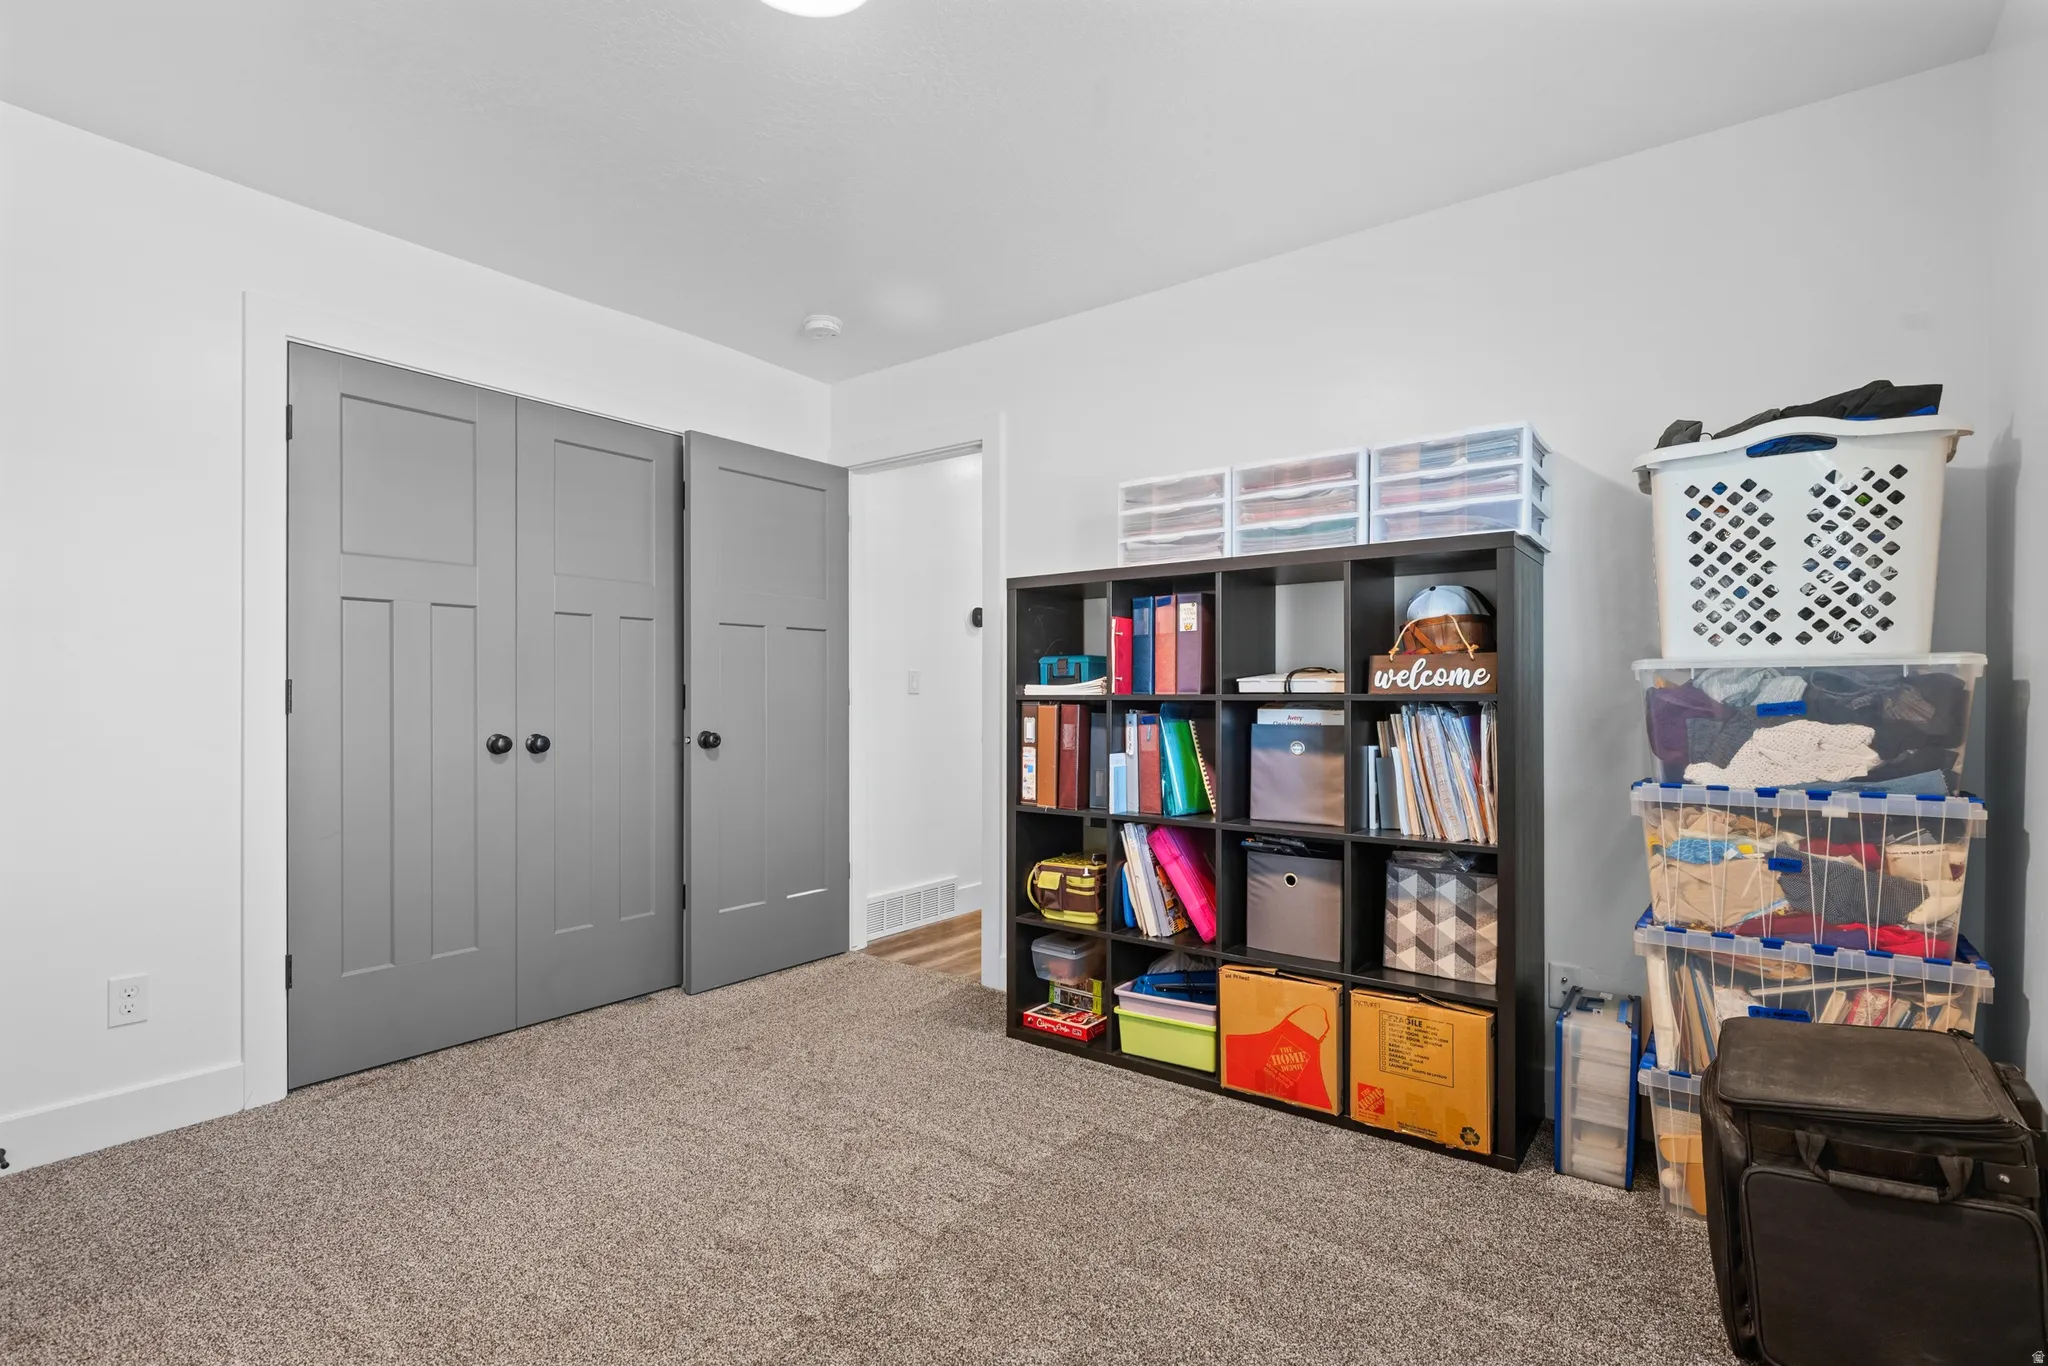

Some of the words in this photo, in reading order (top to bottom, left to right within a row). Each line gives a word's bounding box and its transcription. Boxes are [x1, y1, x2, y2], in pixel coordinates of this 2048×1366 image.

[1374, 658, 1491, 690] welcome
[1280, 1046, 1294, 1054] THE
[1270, 1051, 1309, 1066] HOME
[1280, 1063, 1304, 1072] DEPOT
[1358, 1087, 1384, 1110] HOME
